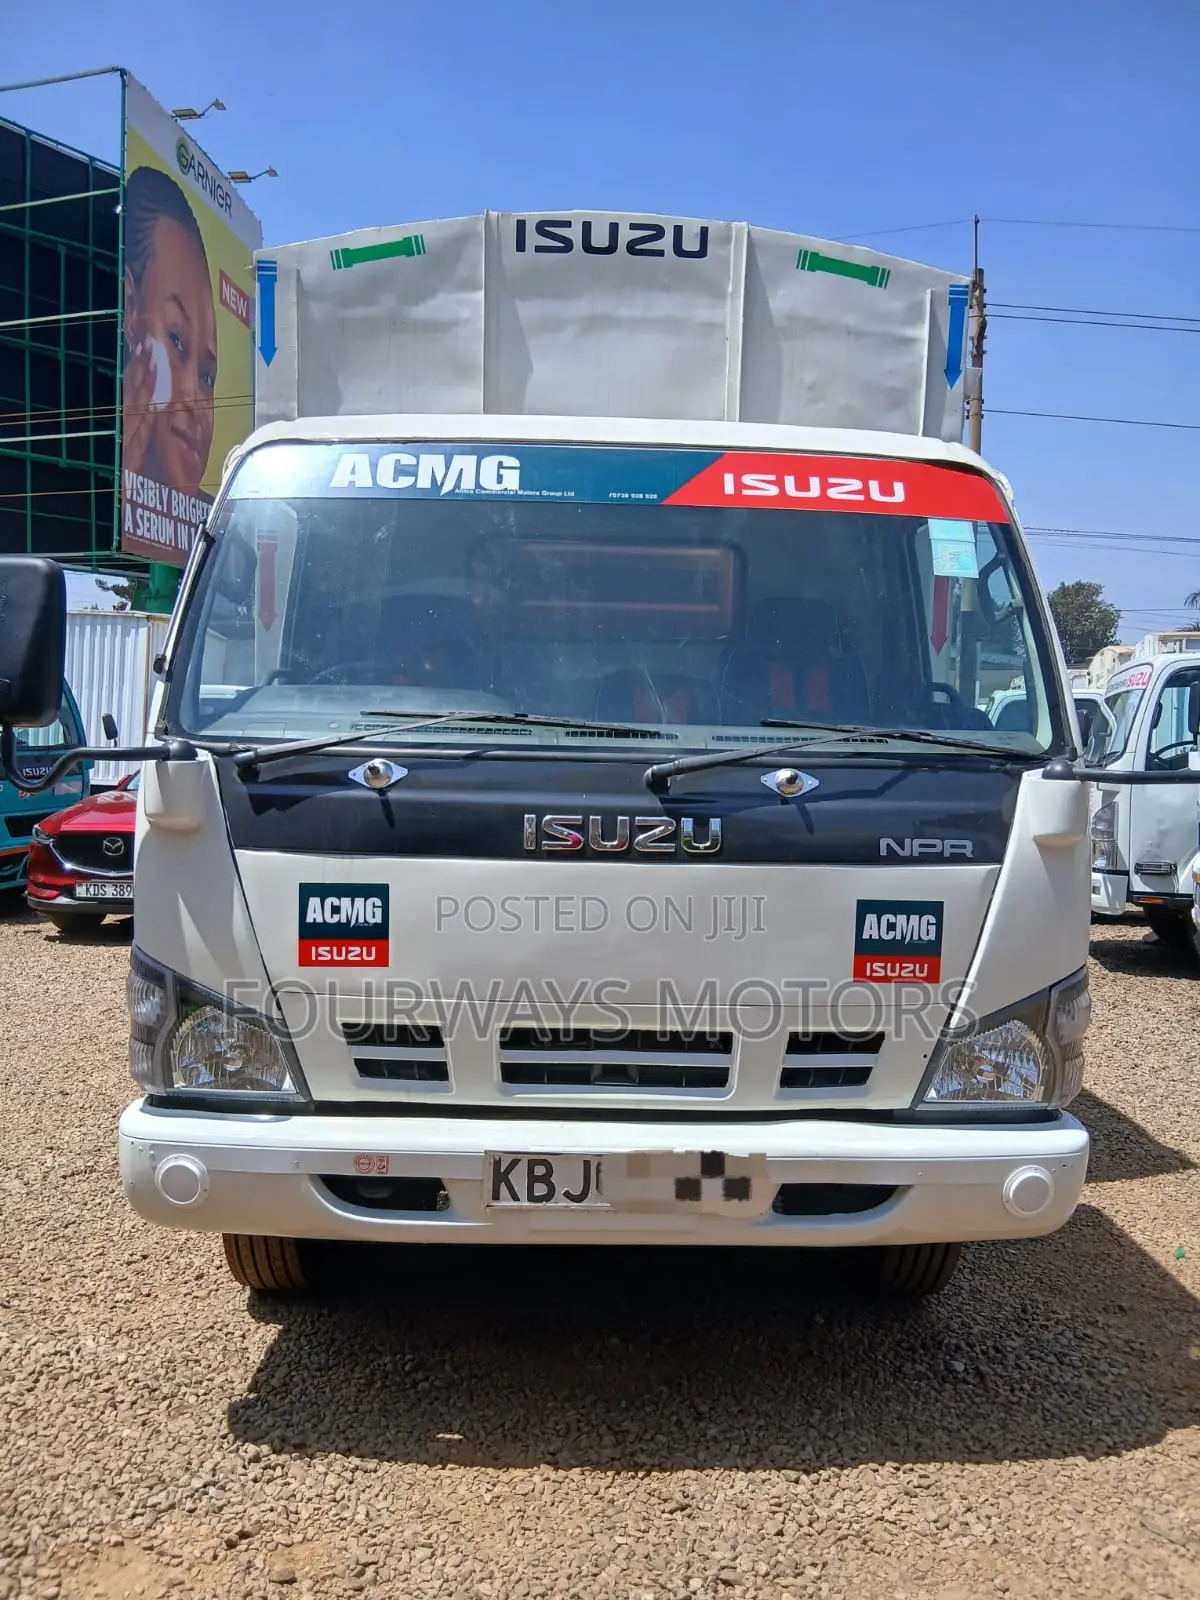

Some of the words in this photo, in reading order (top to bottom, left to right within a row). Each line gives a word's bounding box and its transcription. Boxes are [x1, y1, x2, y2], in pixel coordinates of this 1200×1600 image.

[176, 137, 232, 219] GARNIER
[516, 219, 709, 259] ISUZU
[222, 279, 248, 318] NEW
[125, 469, 169, 513] VISIBLY
[330, 453, 521, 496] ACMG
[723, 472, 906, 503] ISUZU
[125, 503, 133, 533] A
[136, 508, 175, 547] SERUM
[178, 522, 188, 551] IN
[523, 813, 723, 853] ISUZU
[880, 837, 974, 858] NPR
[86, 883, 107, 897] KDS
[112, 883, 134, 897] 389
[306, 897, 382, 928] ACMG
[862, 913, 937, 944] ACMG
[312, 946, 376, 960] ISUZU
[866, 962, 928, 977] ISUZU
